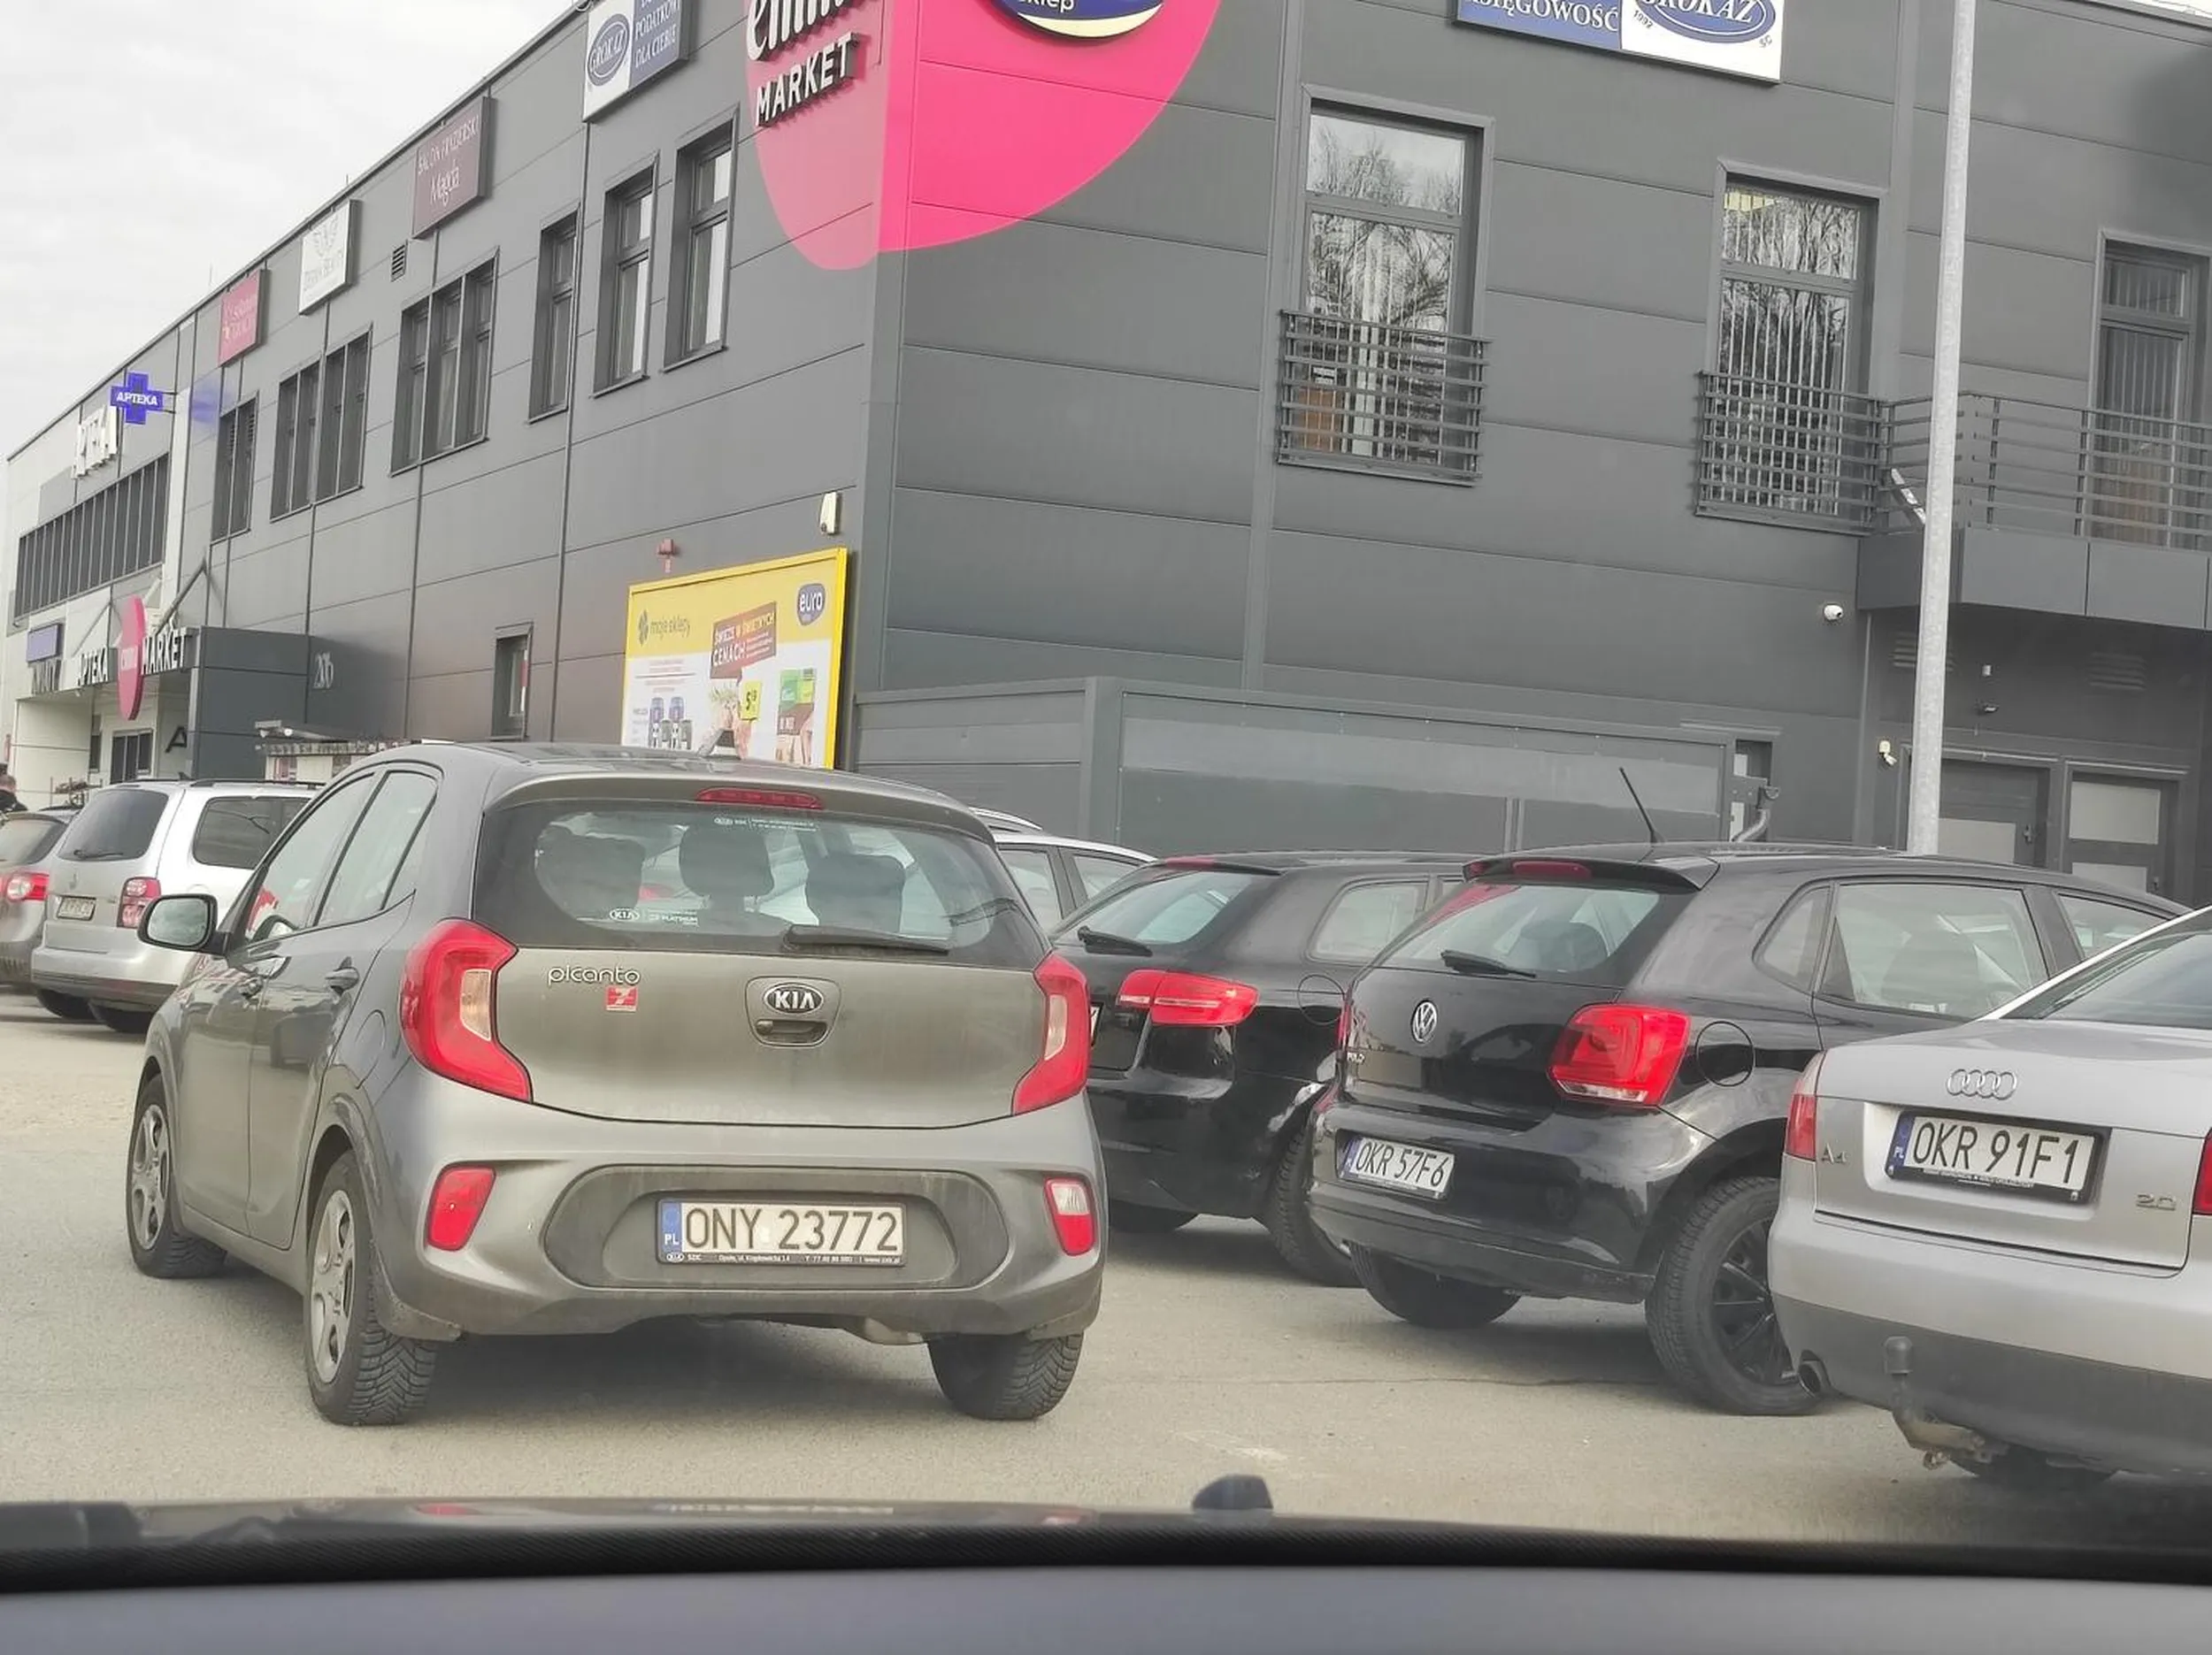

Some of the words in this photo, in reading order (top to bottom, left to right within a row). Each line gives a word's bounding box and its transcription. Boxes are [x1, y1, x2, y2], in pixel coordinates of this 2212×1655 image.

[1466, 0, 1619, 32] ĘGOWOŚĆ
[1642, 0, 1753, 23] OKAZ
[755, 30, 853, 127] MARKET
[116, 392, 158, 406] APTEKA
[799, 590, 824, 612] euro
[142, 626, 188, 676] MARKET
[547, 964, 640, 985] picanto
[774, 990, 816, 1010] KIA
[1356, 1141, 1394, 1176] OKR
[1394, 1148, 1449, 1187] 57F6
[1913, 1122, 1978, 1170] OKR
[1985, 1129, 2079, 1184] 91F1
[664, 1233, 680, 1245] PL
[686, 1207, 762, 1250] ONY
[778, 1209, 898, 1252] 23772
